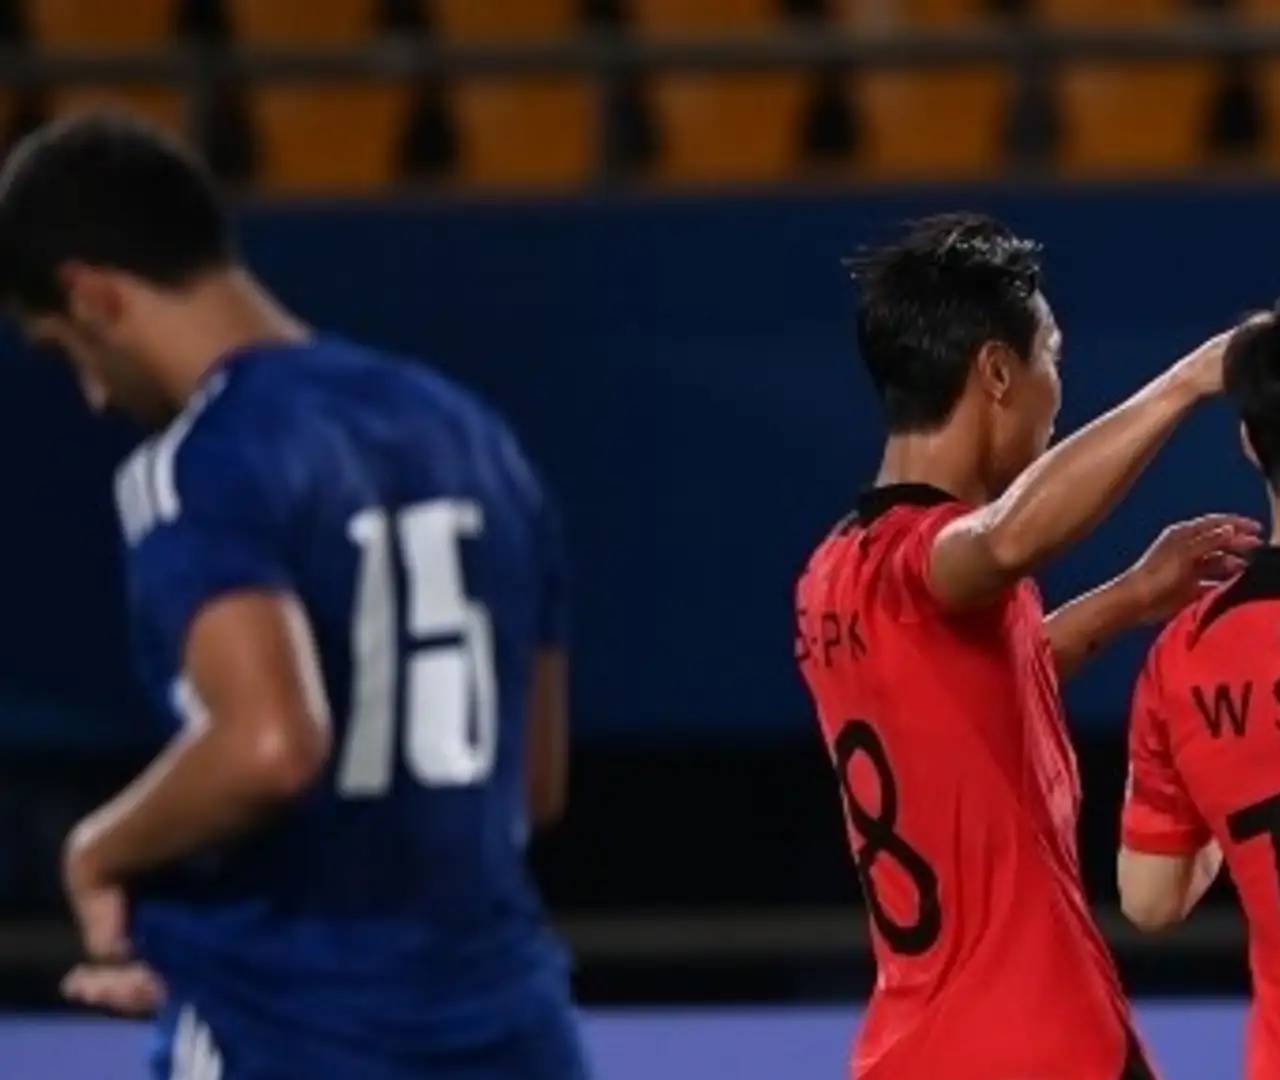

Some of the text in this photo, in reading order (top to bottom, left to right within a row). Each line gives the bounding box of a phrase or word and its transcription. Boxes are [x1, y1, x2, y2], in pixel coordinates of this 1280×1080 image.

[337, 497, 499, 800] 15
[1190, 680, 1254, 739] W
[832, 719, 942, 957] 8
